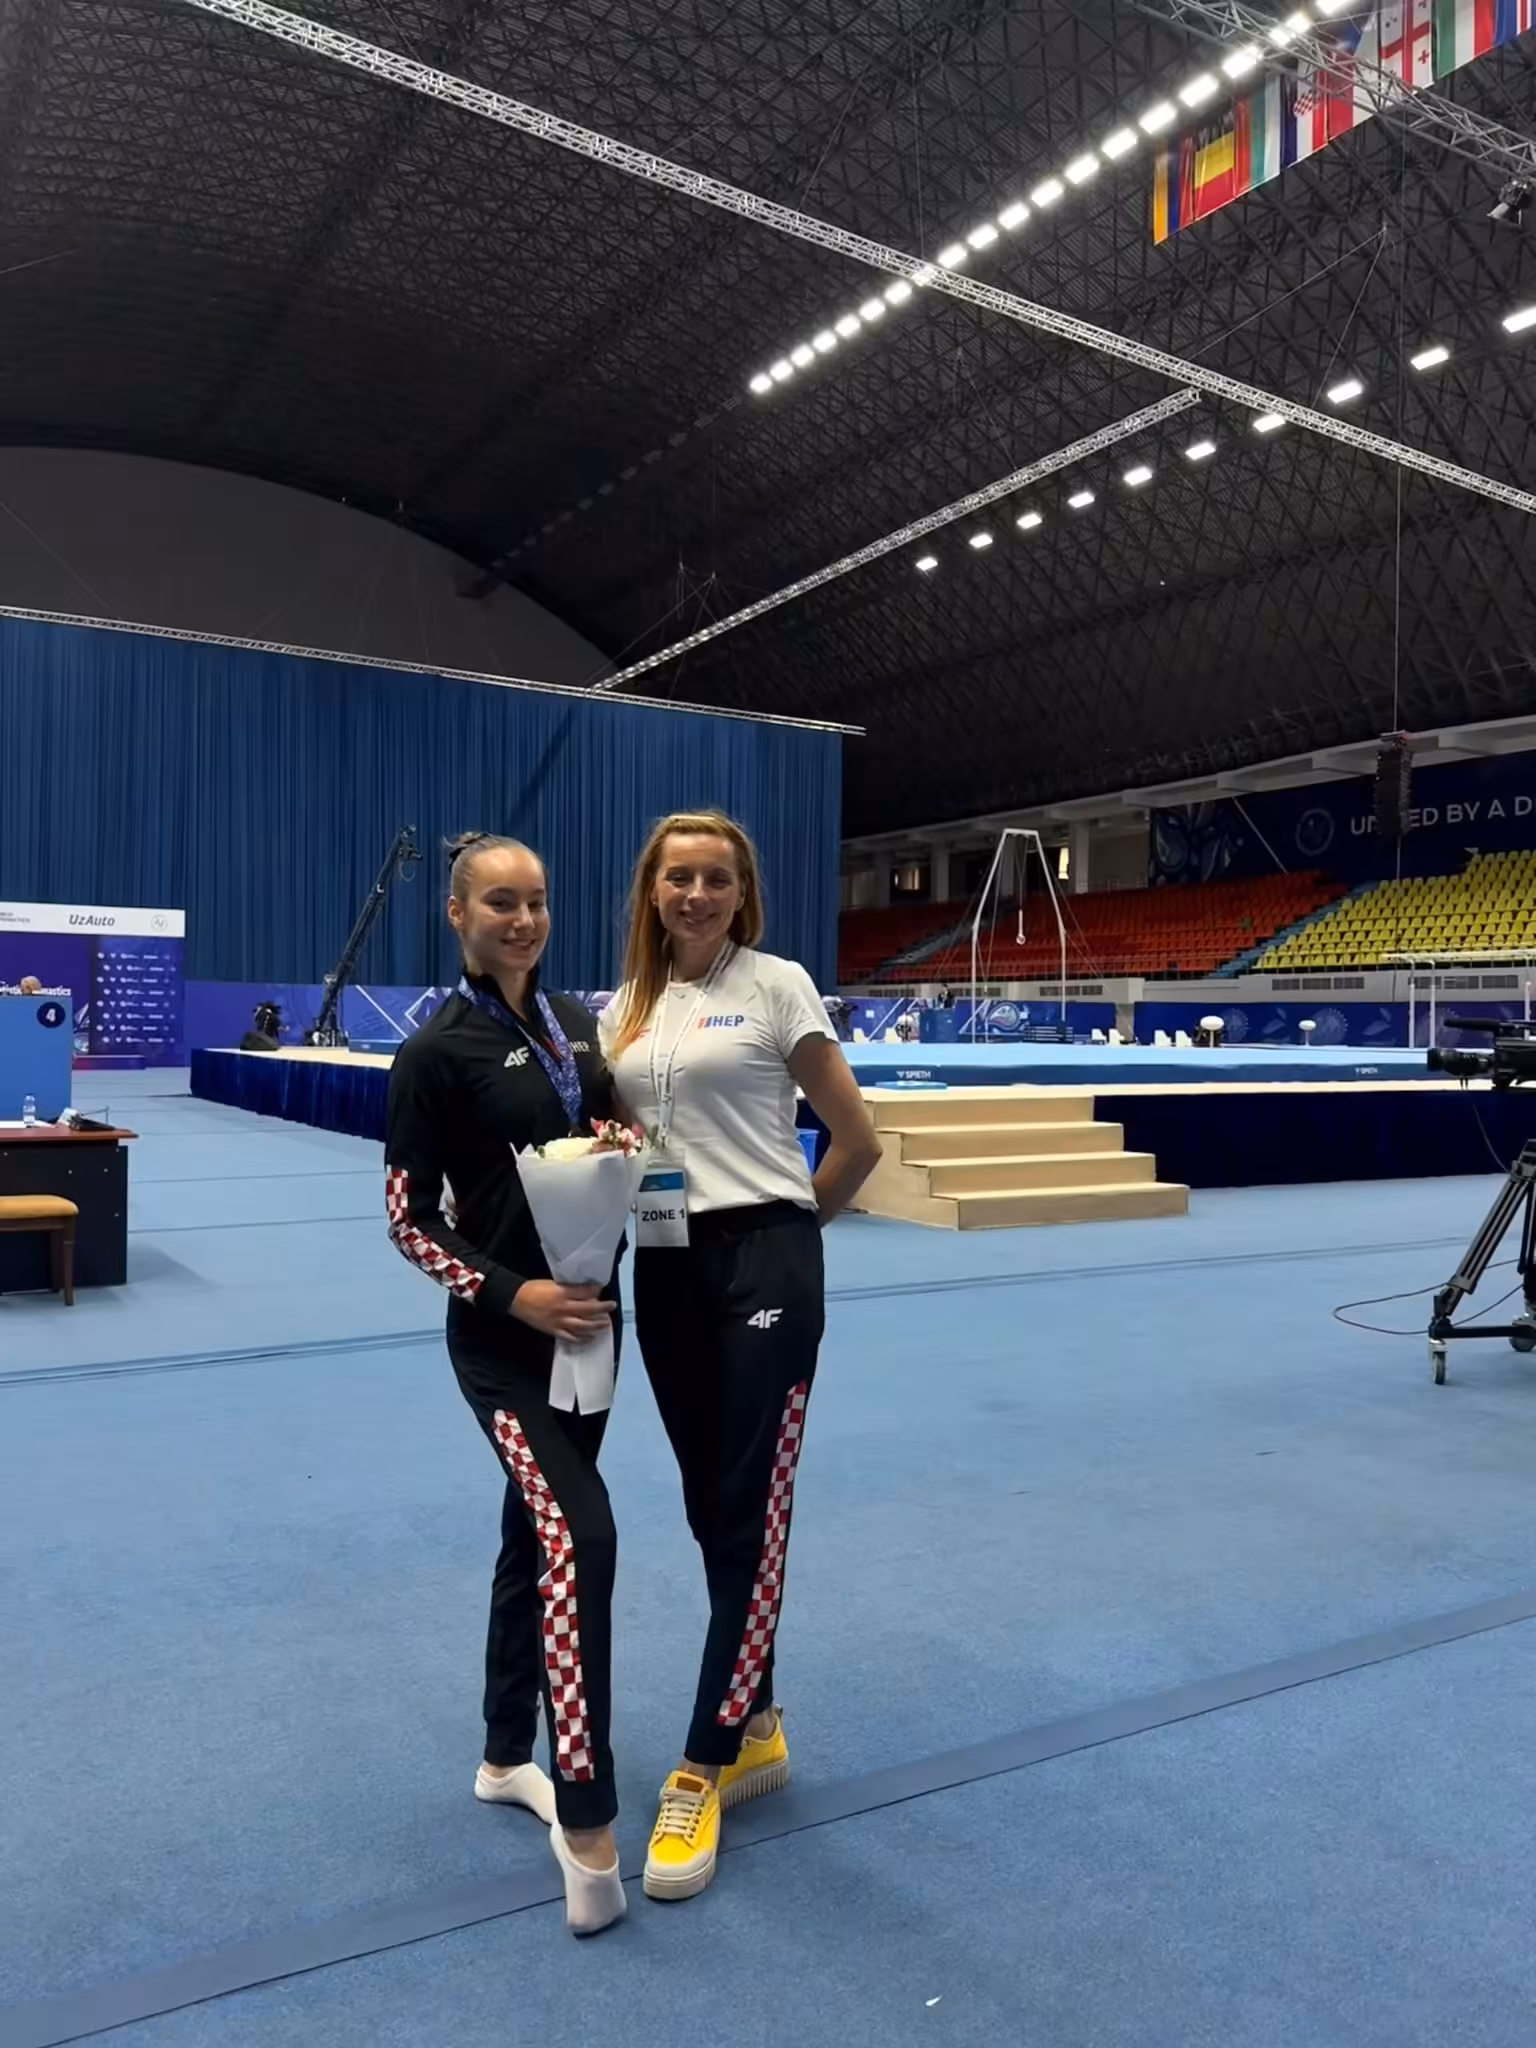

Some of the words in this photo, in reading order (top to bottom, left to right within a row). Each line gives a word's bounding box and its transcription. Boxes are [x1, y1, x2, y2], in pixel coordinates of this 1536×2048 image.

[1351, 807, 1438, 835] UNED
[1446, 801, 1480, 824] BY
[1487, 799, 1506, 819] A
[69, 914, 115, 927] UzAuto
[46, 1008, 57, 1023] 4
[711, 1014, 745, 1028] HEP
[504, 1046, 530, 1068] 4F
[641, 1209, 676, 1221] ZONE
[679, 1207, 686, 1219] 1
[747, 1308, 784, 1329] 4F
